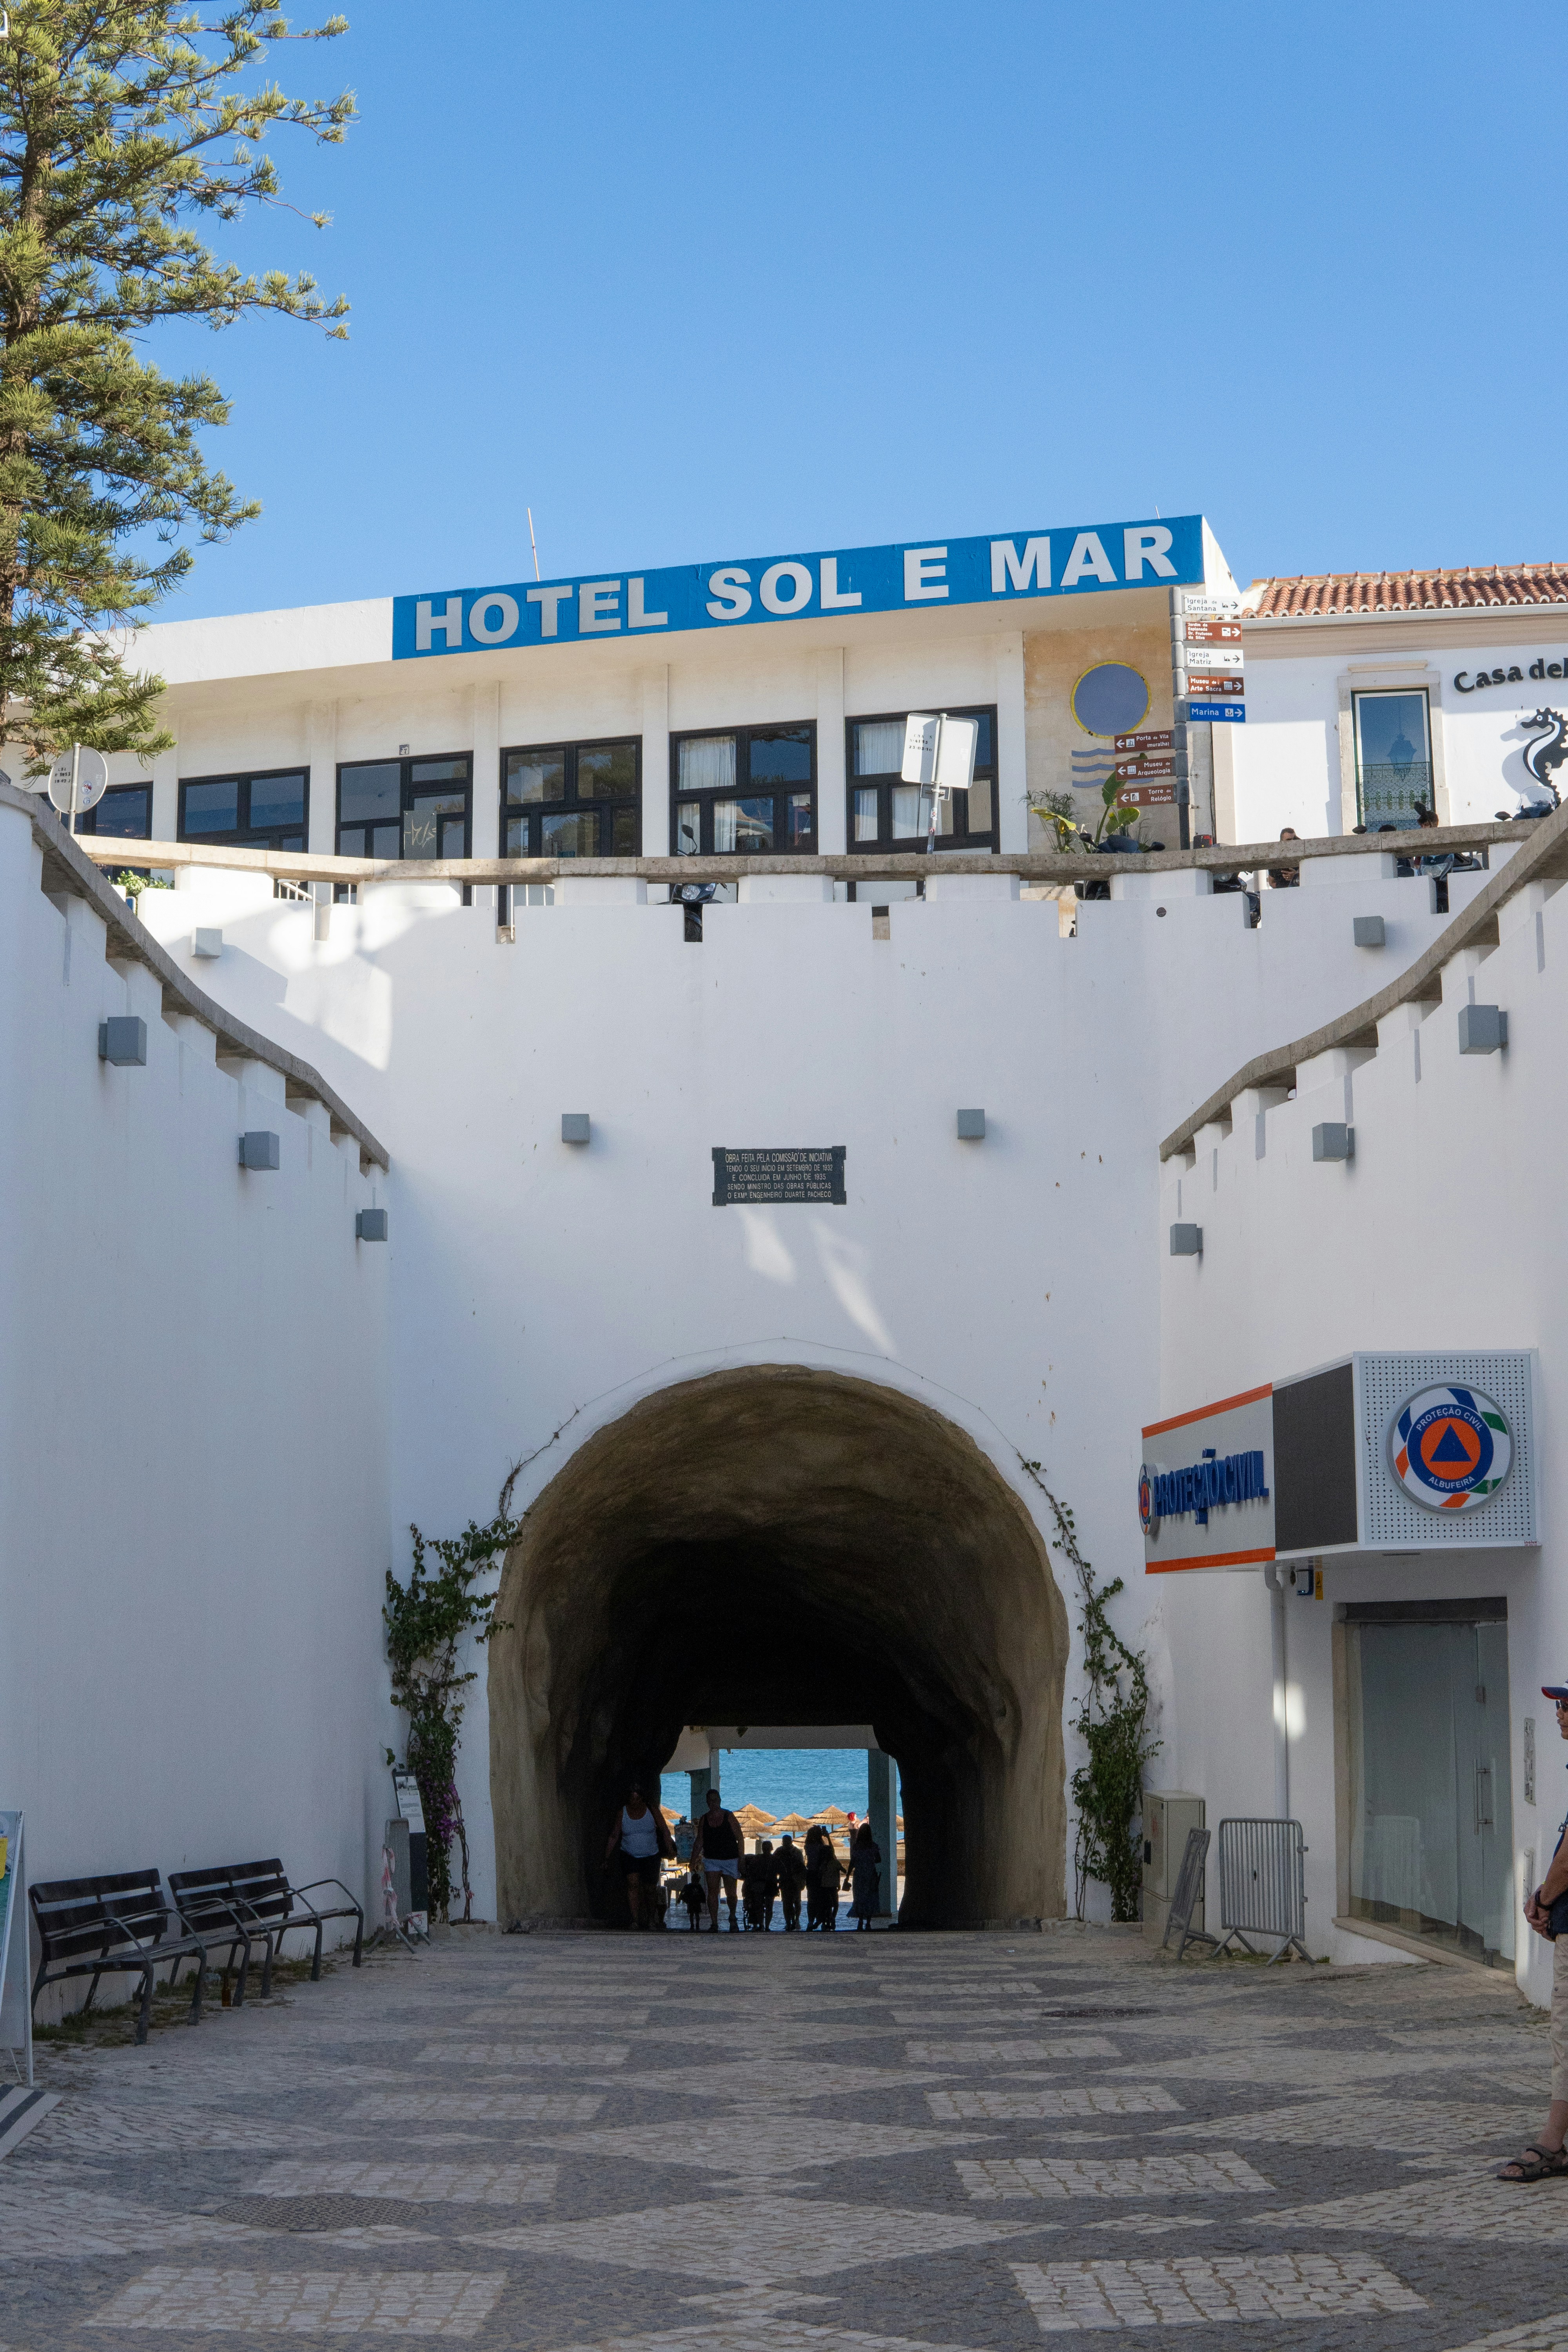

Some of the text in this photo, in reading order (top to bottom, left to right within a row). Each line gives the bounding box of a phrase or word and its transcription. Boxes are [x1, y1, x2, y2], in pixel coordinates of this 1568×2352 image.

[416, 526, 1178, 651] HOTEL SOL E MAR
[1454, 666, 1524, 693] Casa
[725, 1152, 833, 1163] OBRA FEITA PELA COMISSÃO DE INICIATIVA
[761, 1163, 776, 1171] INÍCIO
[1416, 1406, 1484, 1432] PROTEÇÃO CIVIL
[1154, 1448, 1269, 1525] PROTEÇÃO CIVIL
[1428, 1476, 1475, 1489] ALBUFEIRA
